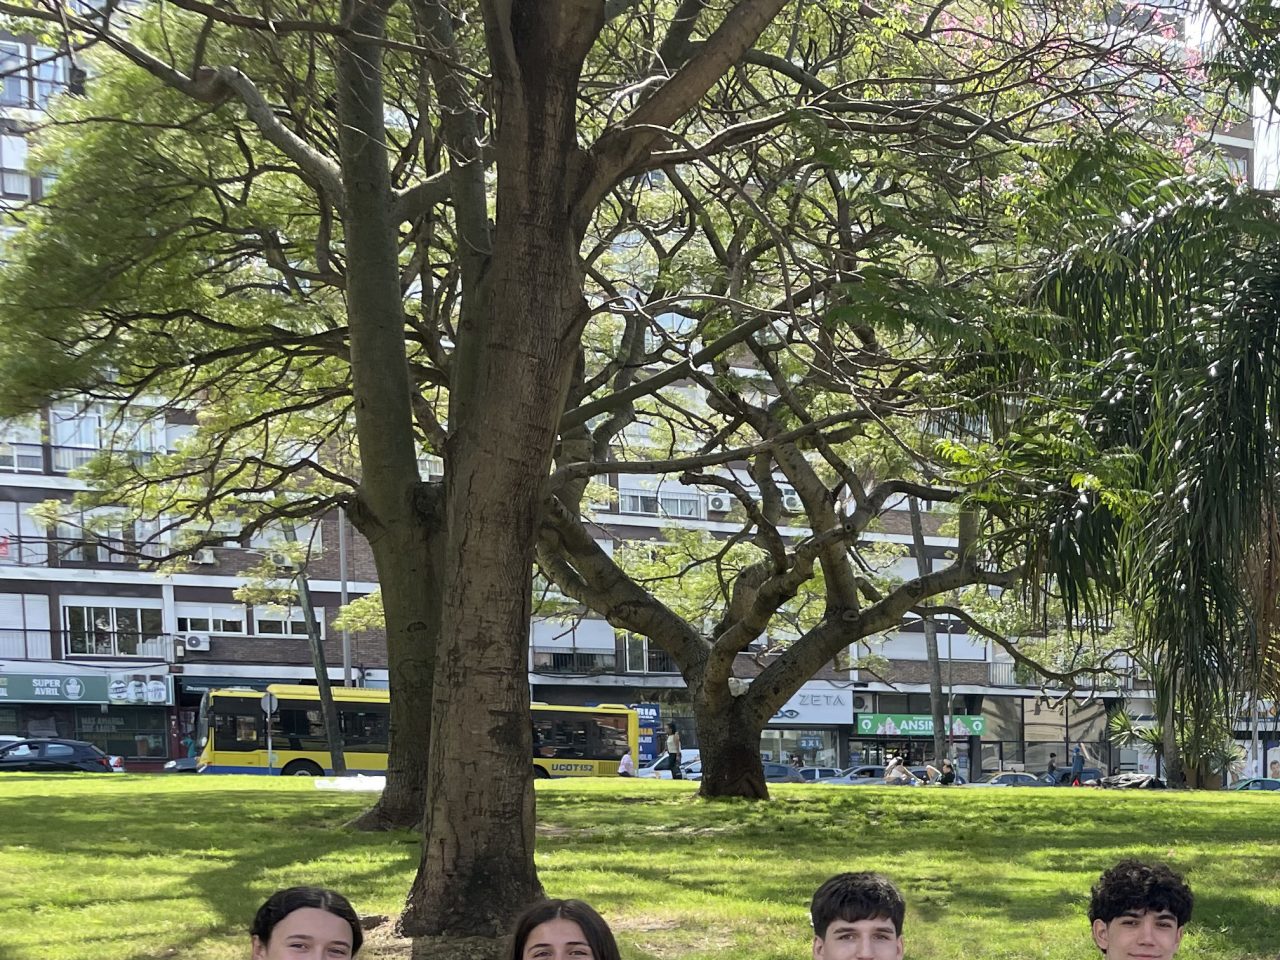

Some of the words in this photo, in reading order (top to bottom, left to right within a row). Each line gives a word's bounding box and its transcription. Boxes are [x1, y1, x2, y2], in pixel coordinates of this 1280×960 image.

[32, 678, 61, 687] SUPER
[34, 687, 60, 696] AVRIL
[799, 694, 845, 706] ZETA
